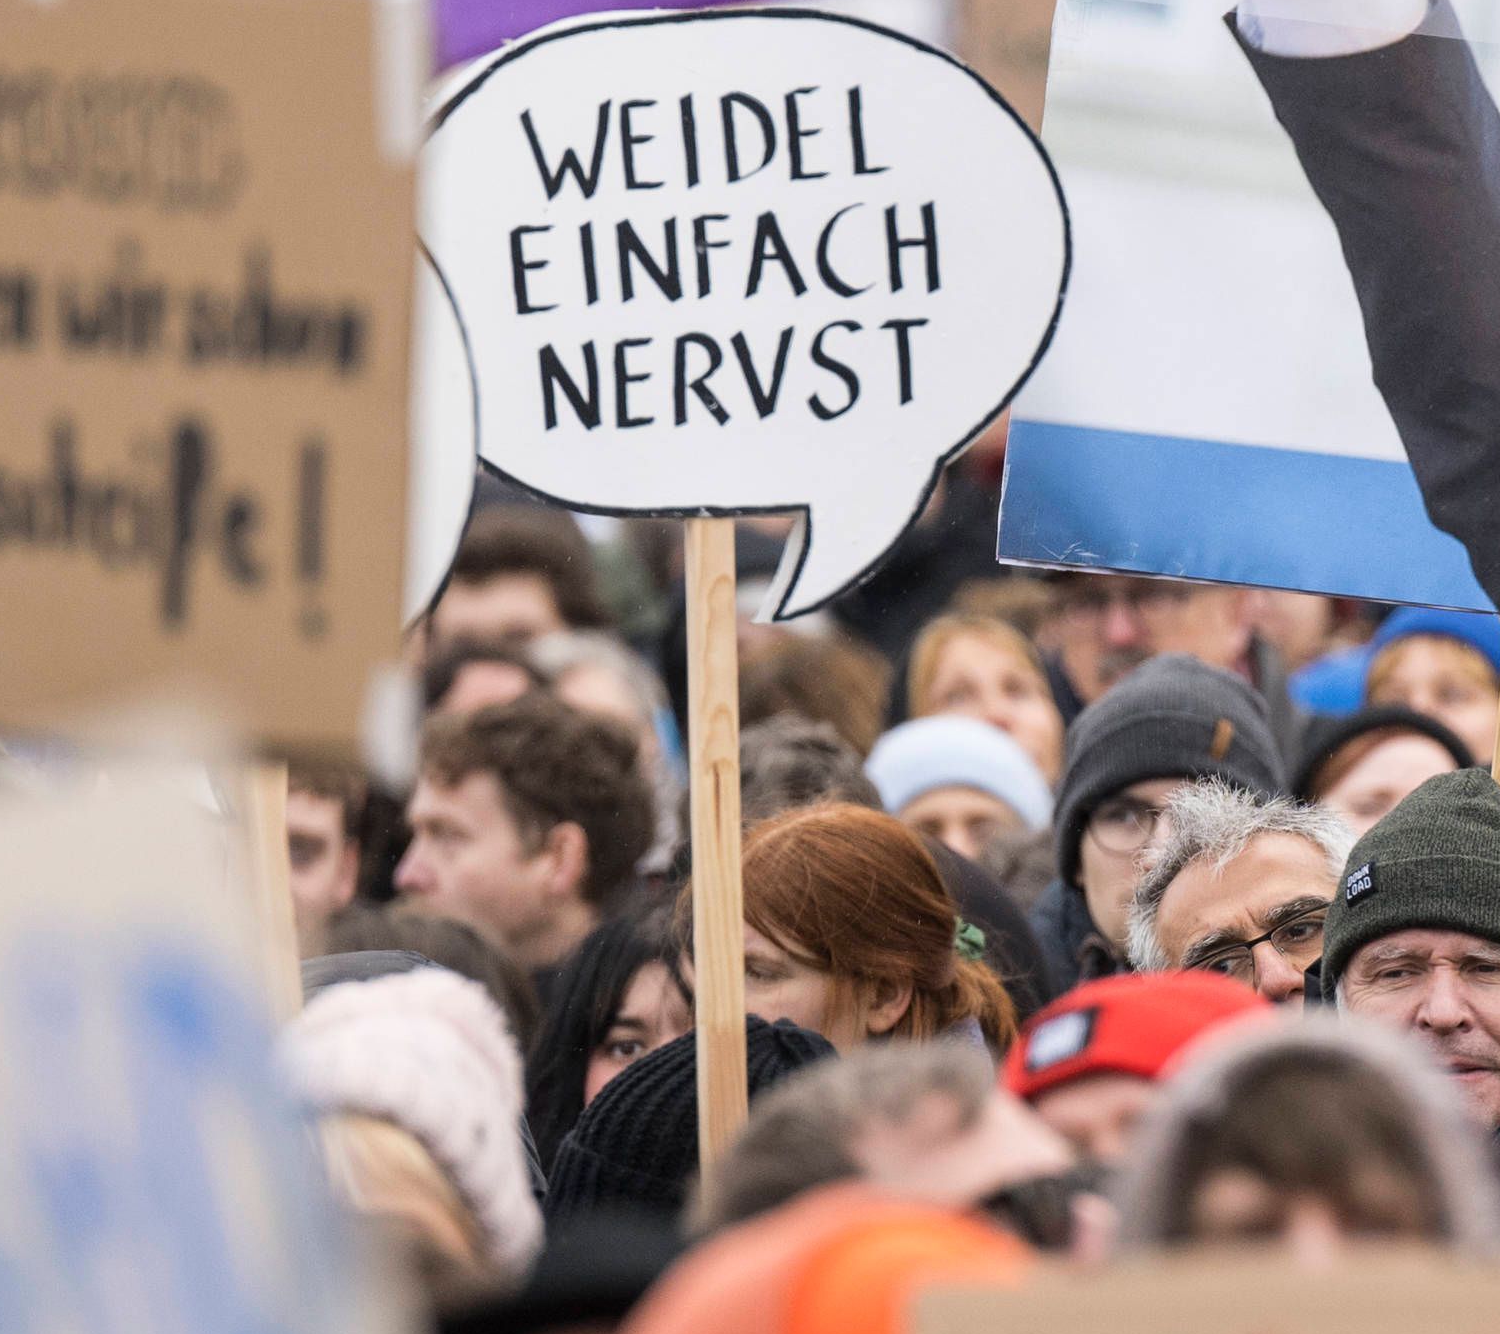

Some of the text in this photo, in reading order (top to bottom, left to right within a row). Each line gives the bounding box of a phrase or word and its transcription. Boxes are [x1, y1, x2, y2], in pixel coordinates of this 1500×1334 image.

[519, 83, 893, 202] WEIDEL
[508, 200, 942, 316] EINFACH
[538, 317, 931, 432] NERVST
[1346, 876, 1372, 900] LOAD
